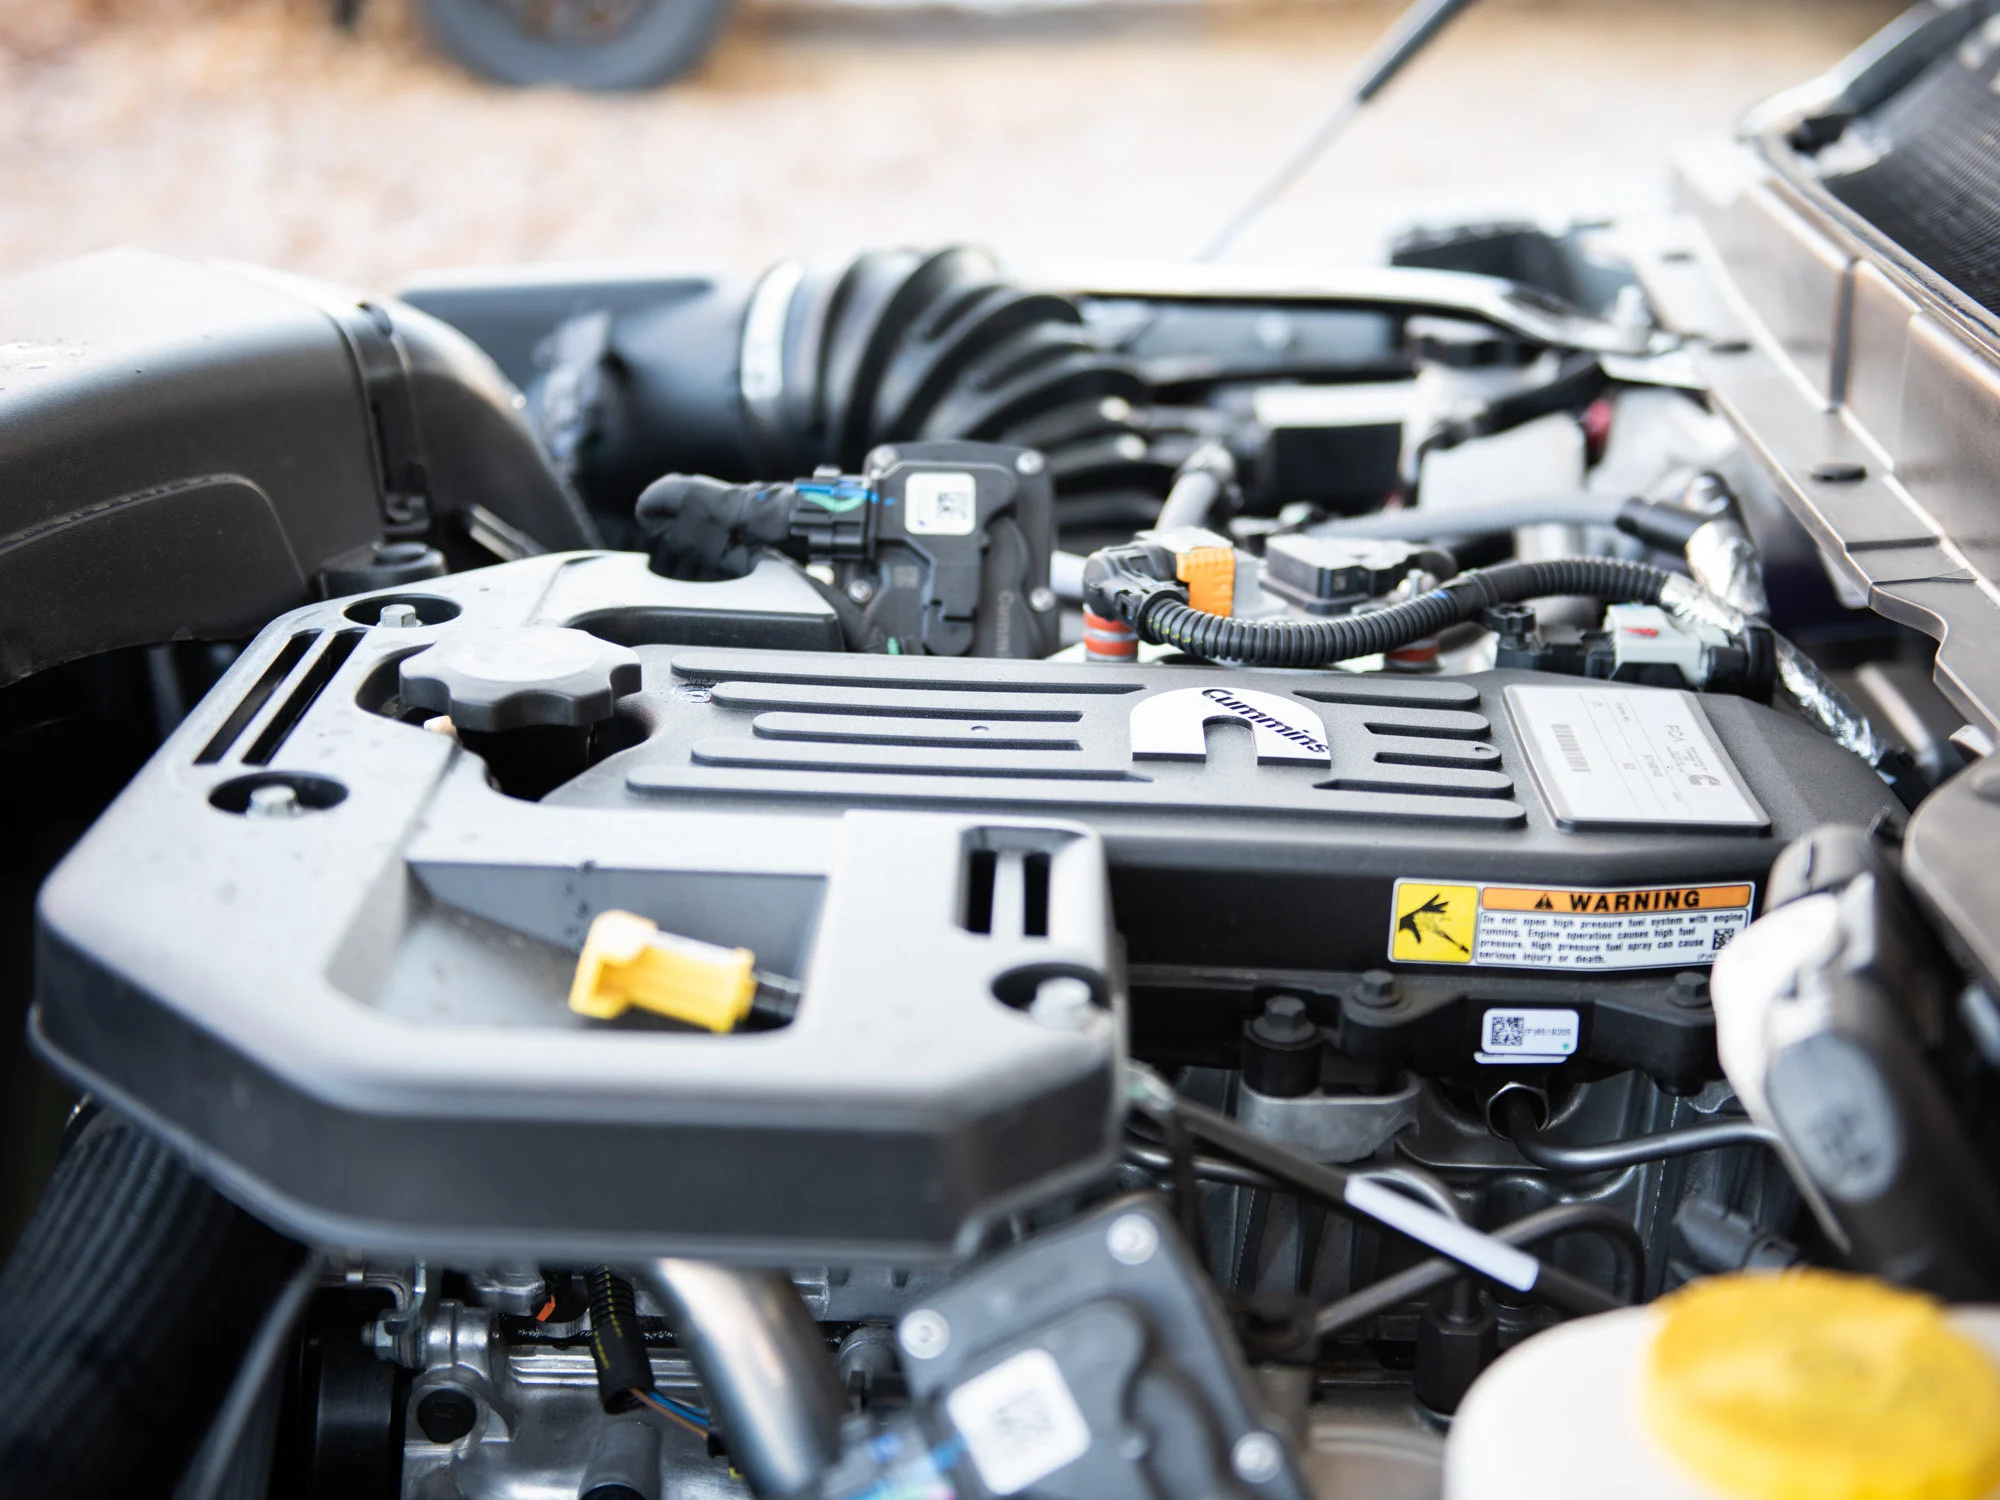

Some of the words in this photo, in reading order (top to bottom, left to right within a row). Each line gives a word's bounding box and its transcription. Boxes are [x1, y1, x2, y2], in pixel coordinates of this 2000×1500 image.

[1201, 688, 1329, 753] Cummins
[1569, 890, 1700, 912] WARNING
[1483, 915, 1495, 923] Do
[1502, 917, 1517, 925] not
[1523, 919, 1547, 928] open
[1553, 919, 1575, 928] high
[1581, 920, 1622, 929] pressure
[1628, 919, 1646, 928] fuel
[1651, 917, 1683, 927] system
[1688, 915, 1708, 924] with
[1713, 913, 1743, 923] engine
[1528, 929, 1560, 939] Engine
[1566, 931, 1612, 941] operation
[1617, 931, 1649, 940] causes
[1655, 928, 1674, 939] high
[1678, 927, 1696, 937] fuel
[1531, 941, 1552, 951] High
[1558, 943, 1600, 952] pressure
[1606, 943, 1623, 952] fuel
[1628, 942, 1652, 952] spray
[1657, 941, 1674, 949] can
[1678, 939, 1705, 948] cause
[1479, 951, 1516, 960] serious
[1523, 953, 1552, 964] injury
[1558, 955, 1569, 963] or
